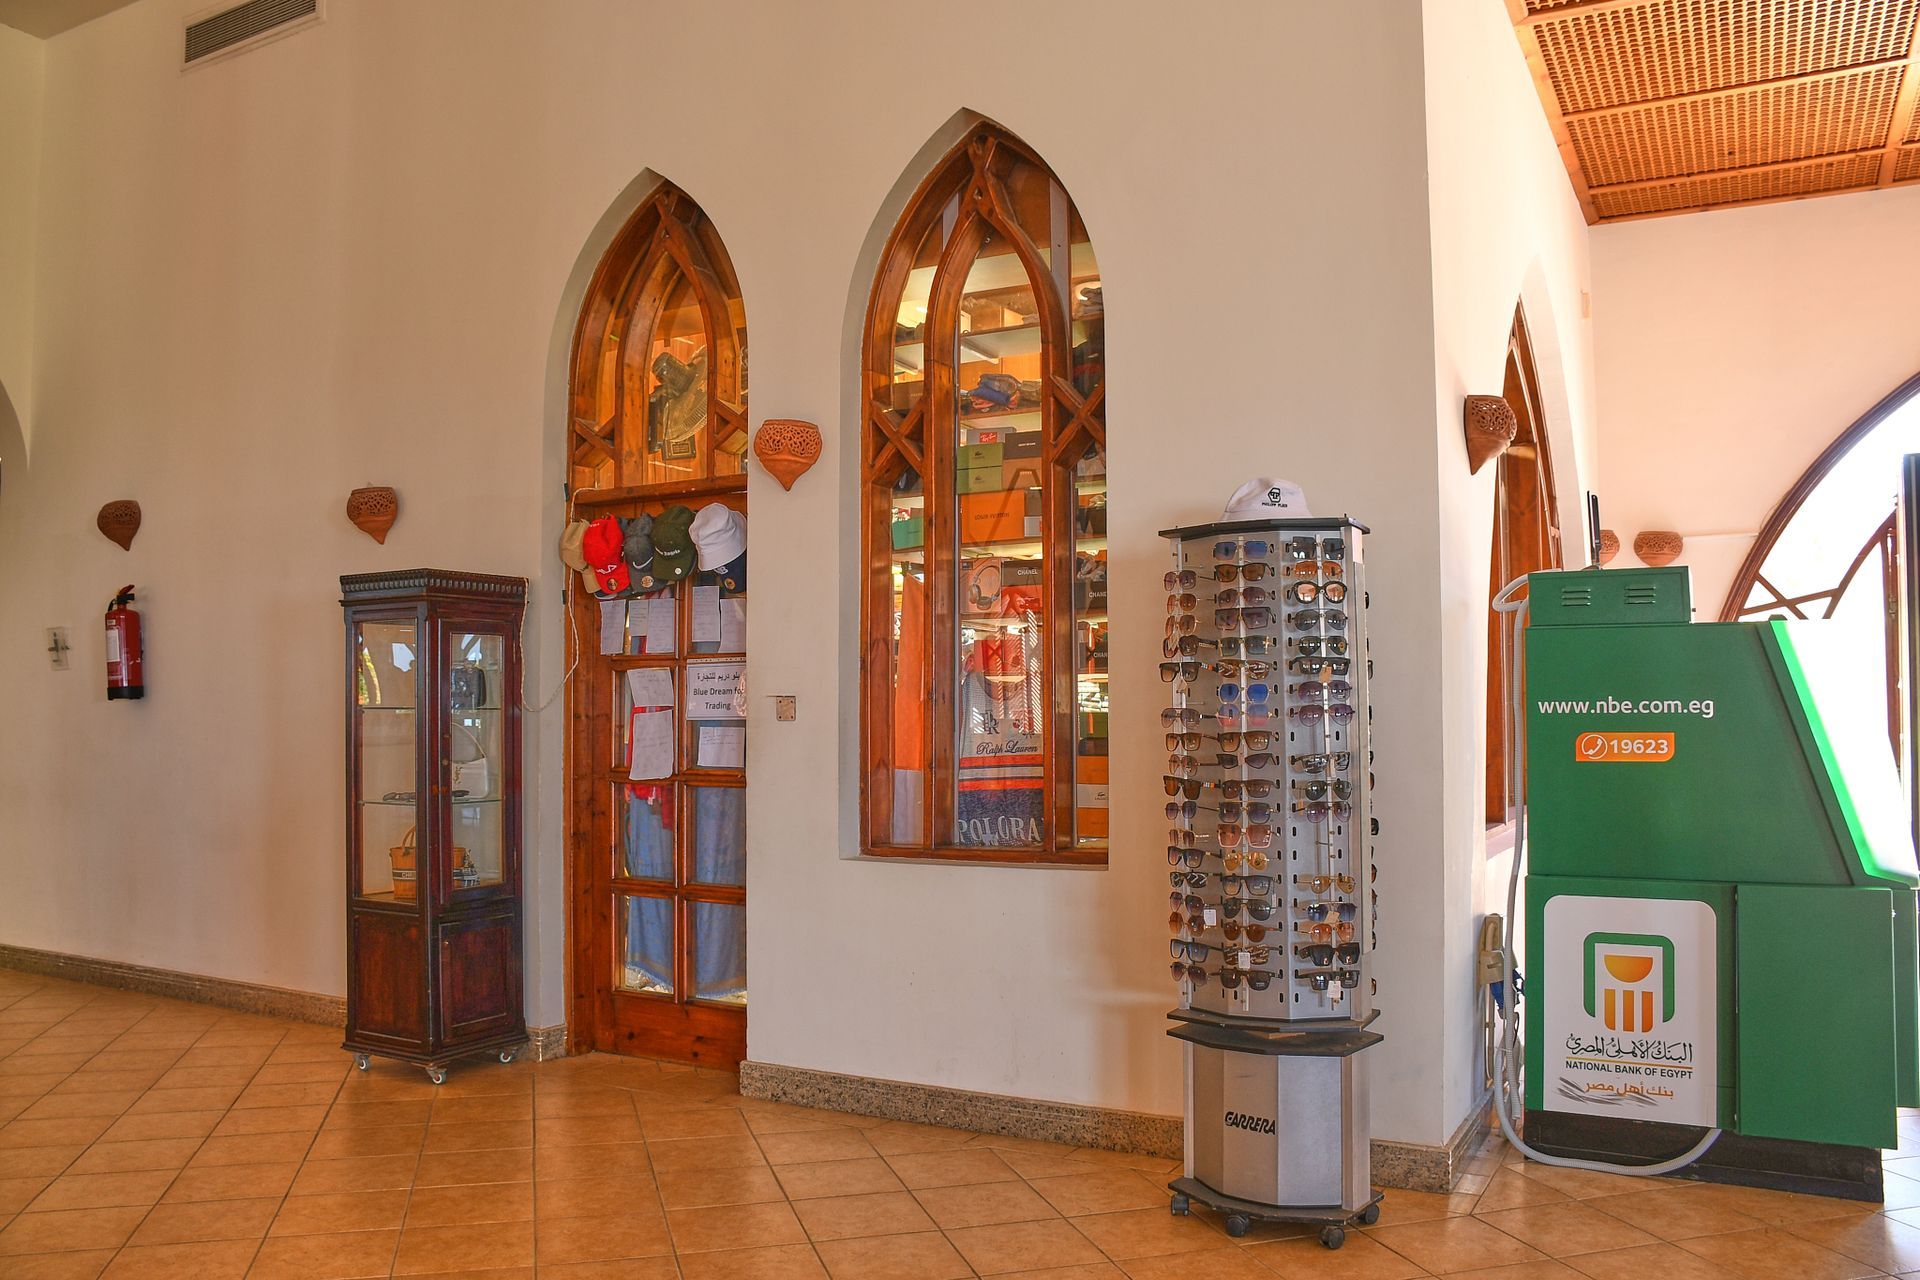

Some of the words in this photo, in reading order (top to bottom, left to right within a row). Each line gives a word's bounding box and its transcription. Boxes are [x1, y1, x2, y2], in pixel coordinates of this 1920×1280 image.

[1017, 568, 1038, 576] CHANEL
[693, 687, 709, 696] Blue
[709, 687, 733, 696] Dream
[704, 701, 732, 711] Trading
[1537, 696, 1714, 719] www.nbe.com.eg
[976, 741, 1003, 758] Ralph
[1004, 739, 1038, 754] Lauren
[1609, 739, 1669, 754] 19623
[1565, 1060, 1612, 1073] NATIONAL
[1614, 1064, 1642, 1076] BANK
[1644, 1067, 1659, 1077] OF
[1660, 1068, 1693, 1080] EGYPT
[1584, 1082, 1614, 1093] مصر
[1646, 1085, 1674, 1100] بنك
[1224, 1110, 1276, 1136] CARRERA
